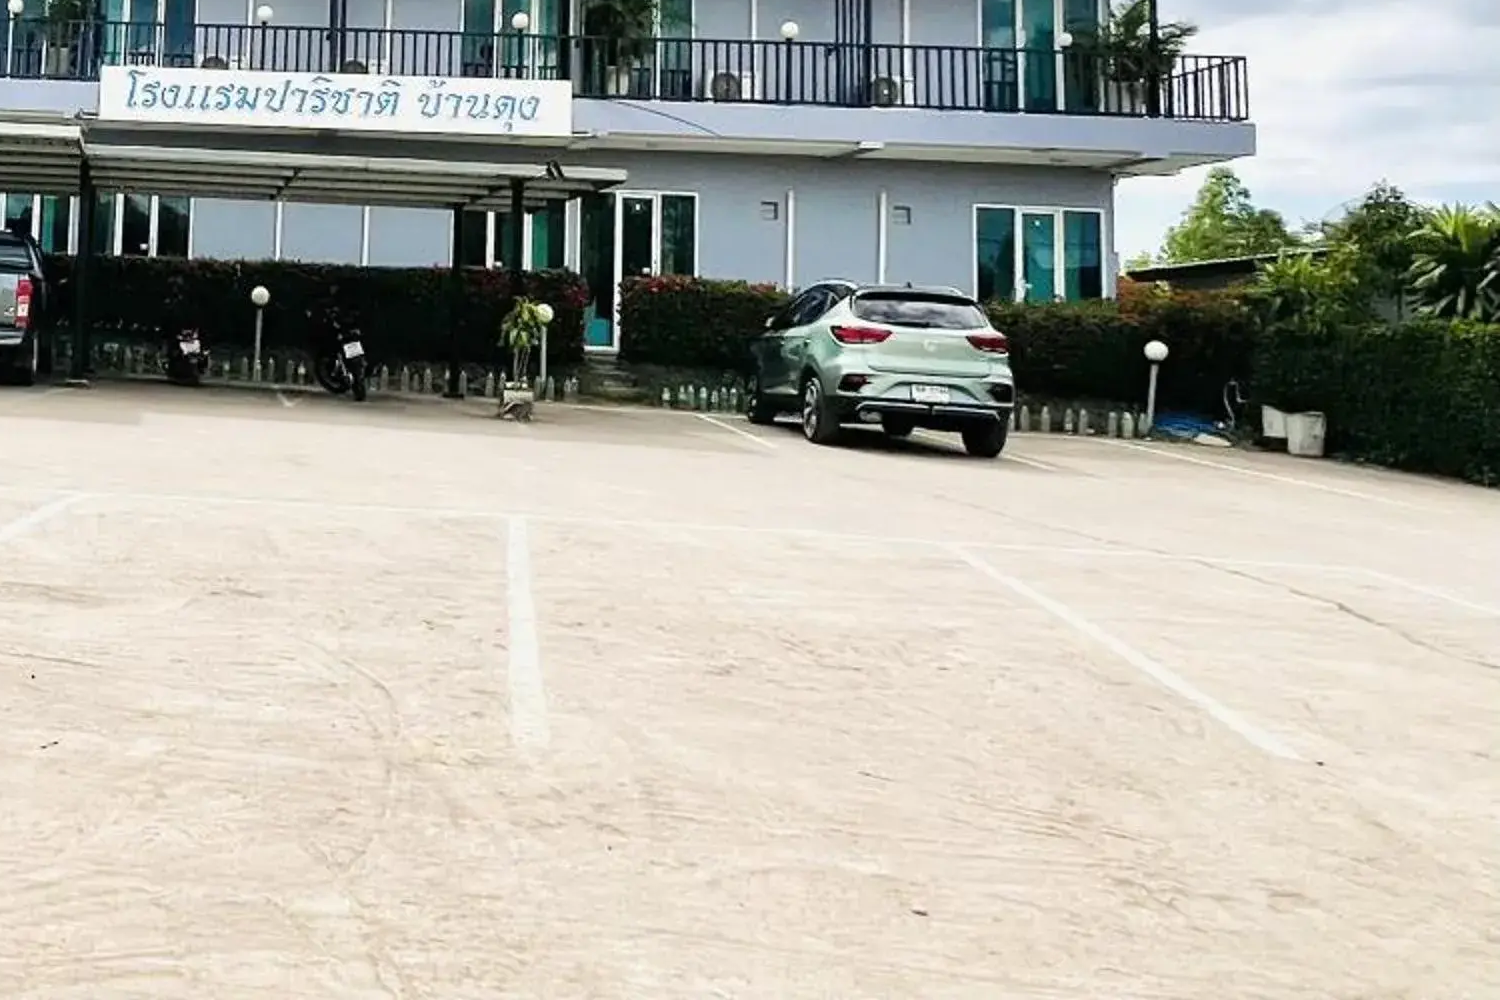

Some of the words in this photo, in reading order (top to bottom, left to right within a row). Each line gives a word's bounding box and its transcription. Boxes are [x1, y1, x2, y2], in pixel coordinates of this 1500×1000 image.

[125, 69, 401, 117] โรงแรมปาริชาติ
[417, 79, 541, 132] บ้านดุง
